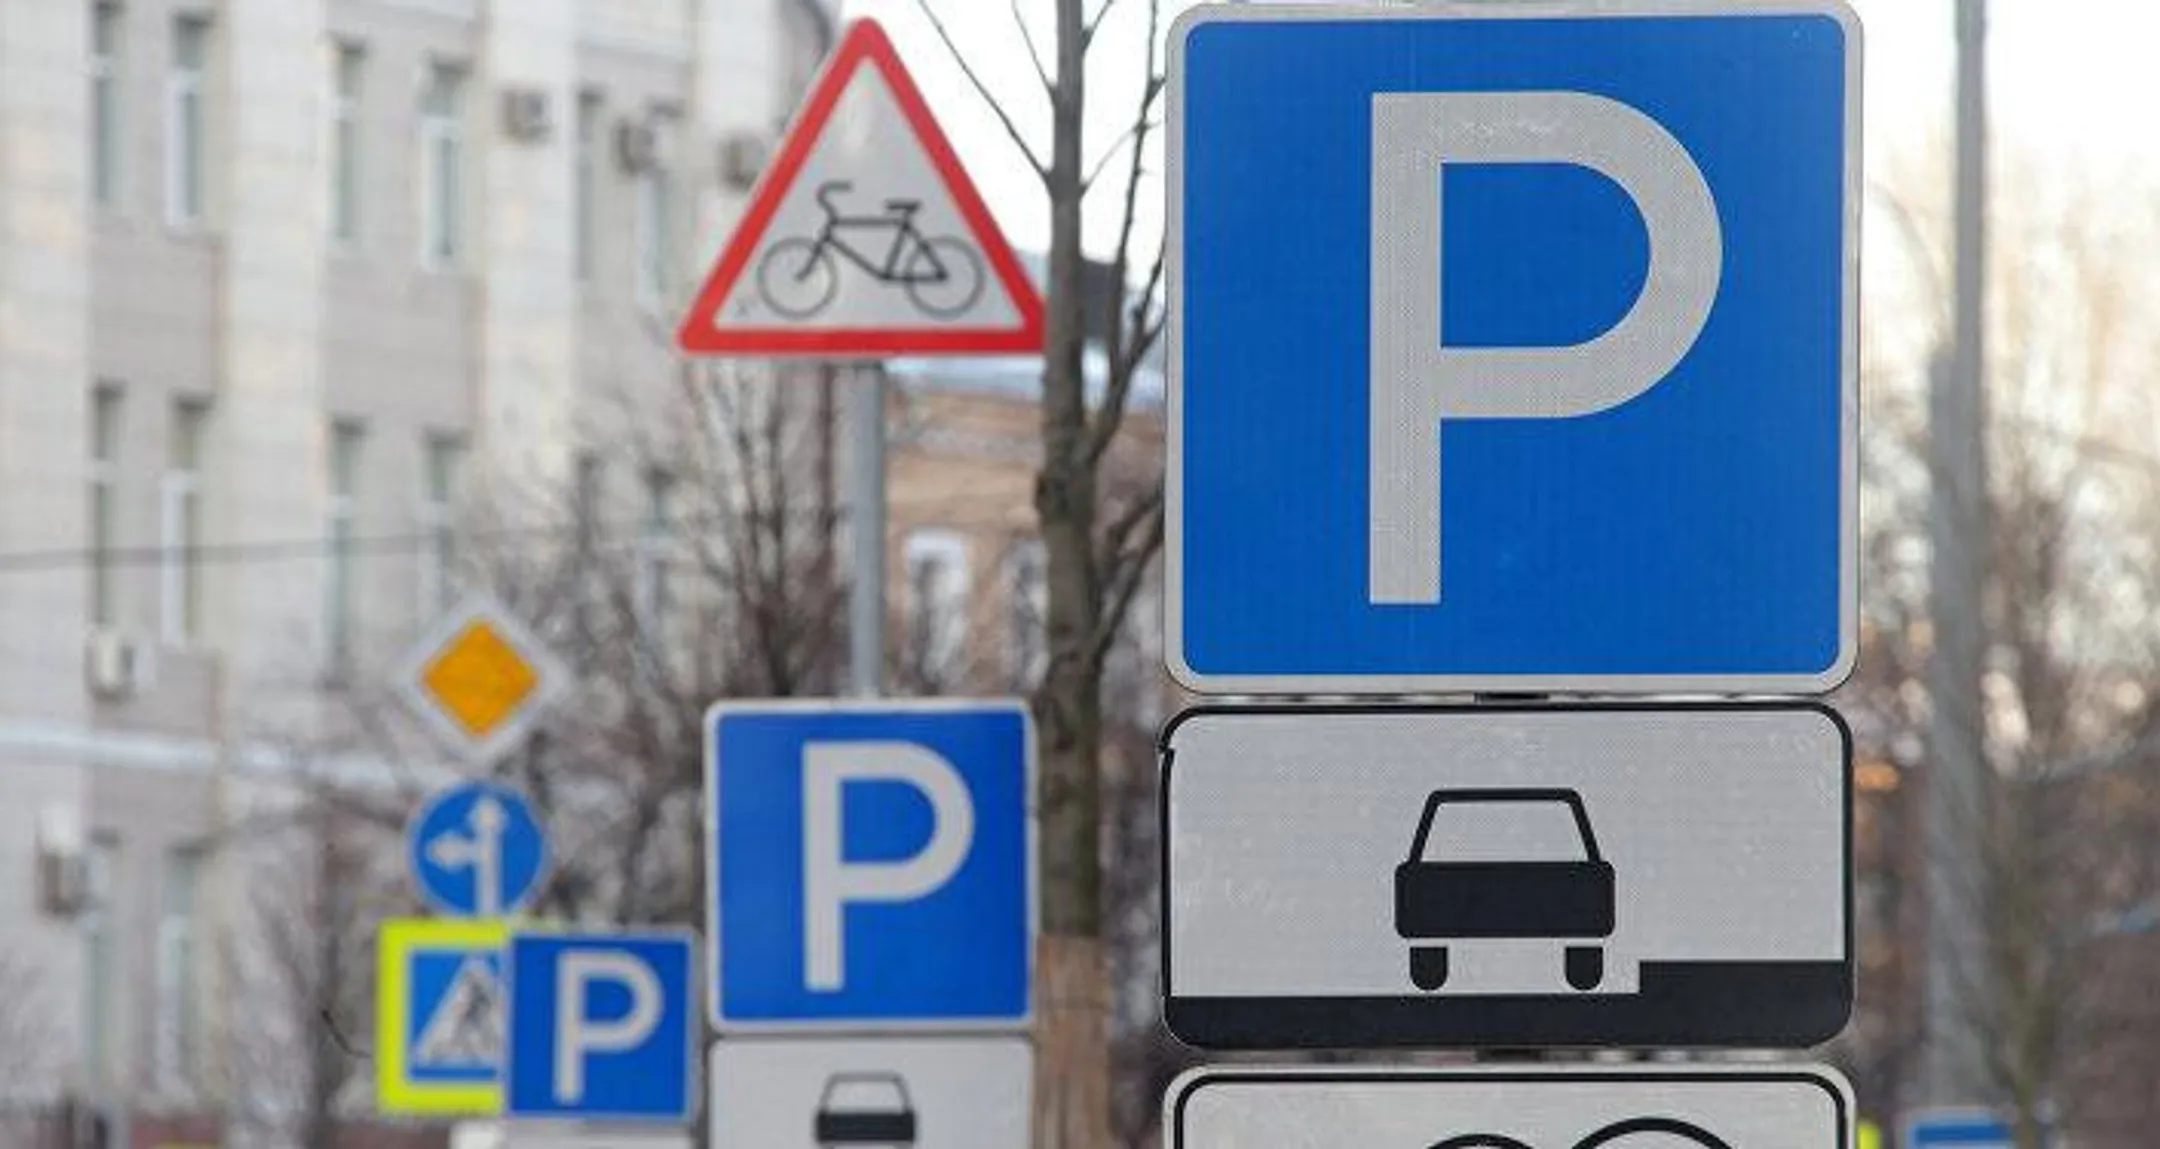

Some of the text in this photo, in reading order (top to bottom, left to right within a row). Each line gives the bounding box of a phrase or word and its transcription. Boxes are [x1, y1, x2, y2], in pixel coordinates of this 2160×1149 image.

[1369, 90, 1723, 605] P
[802, 740, 976, 992] P
[552, 948, 665, 1105] P
